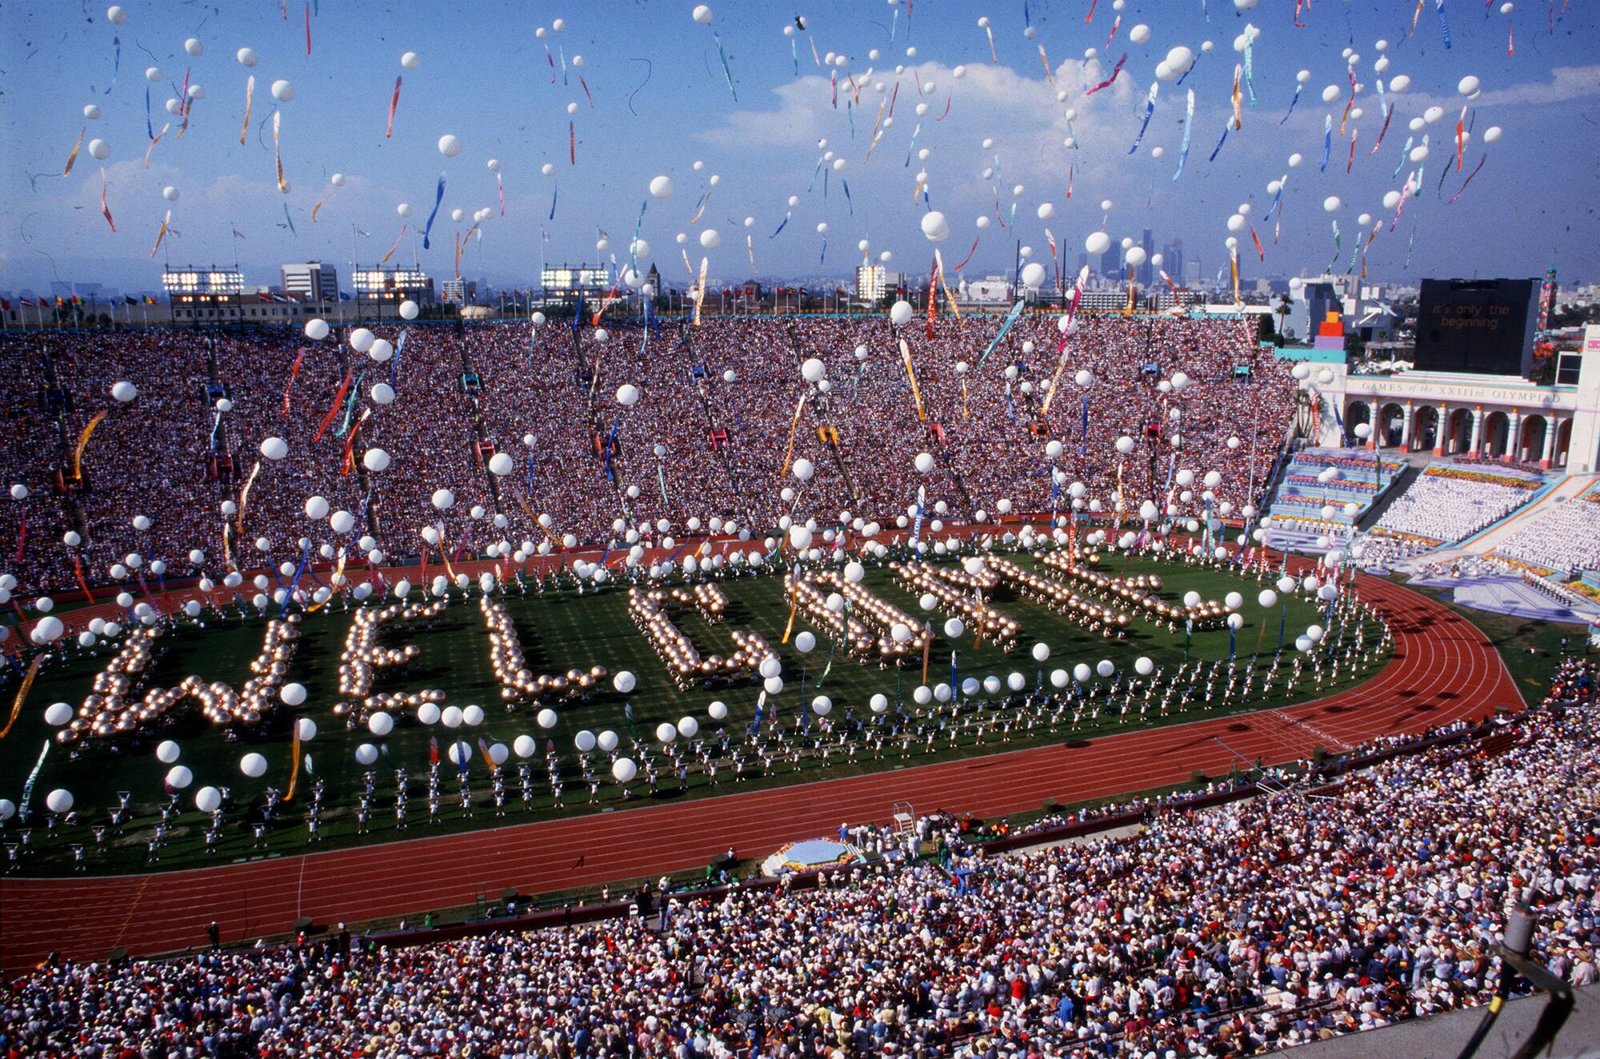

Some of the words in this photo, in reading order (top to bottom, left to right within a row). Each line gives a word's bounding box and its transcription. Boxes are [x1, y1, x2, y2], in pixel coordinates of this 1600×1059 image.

[1456, 304, 1482, 317] only
[1490, 304, 1510, 315] the
[1441, 316, 1498, 330] beginning
[1362, 382, 1403, 392] GAMES
[1407, 383, 1417, 393] of
[1419, 383, 1433, 392] the
[1439, 386, 1485, 398] XXIIIrd
[1492, 389, 1561, 404] OLYMPIAD
[56, 546, 1239, 744] WELCOME
